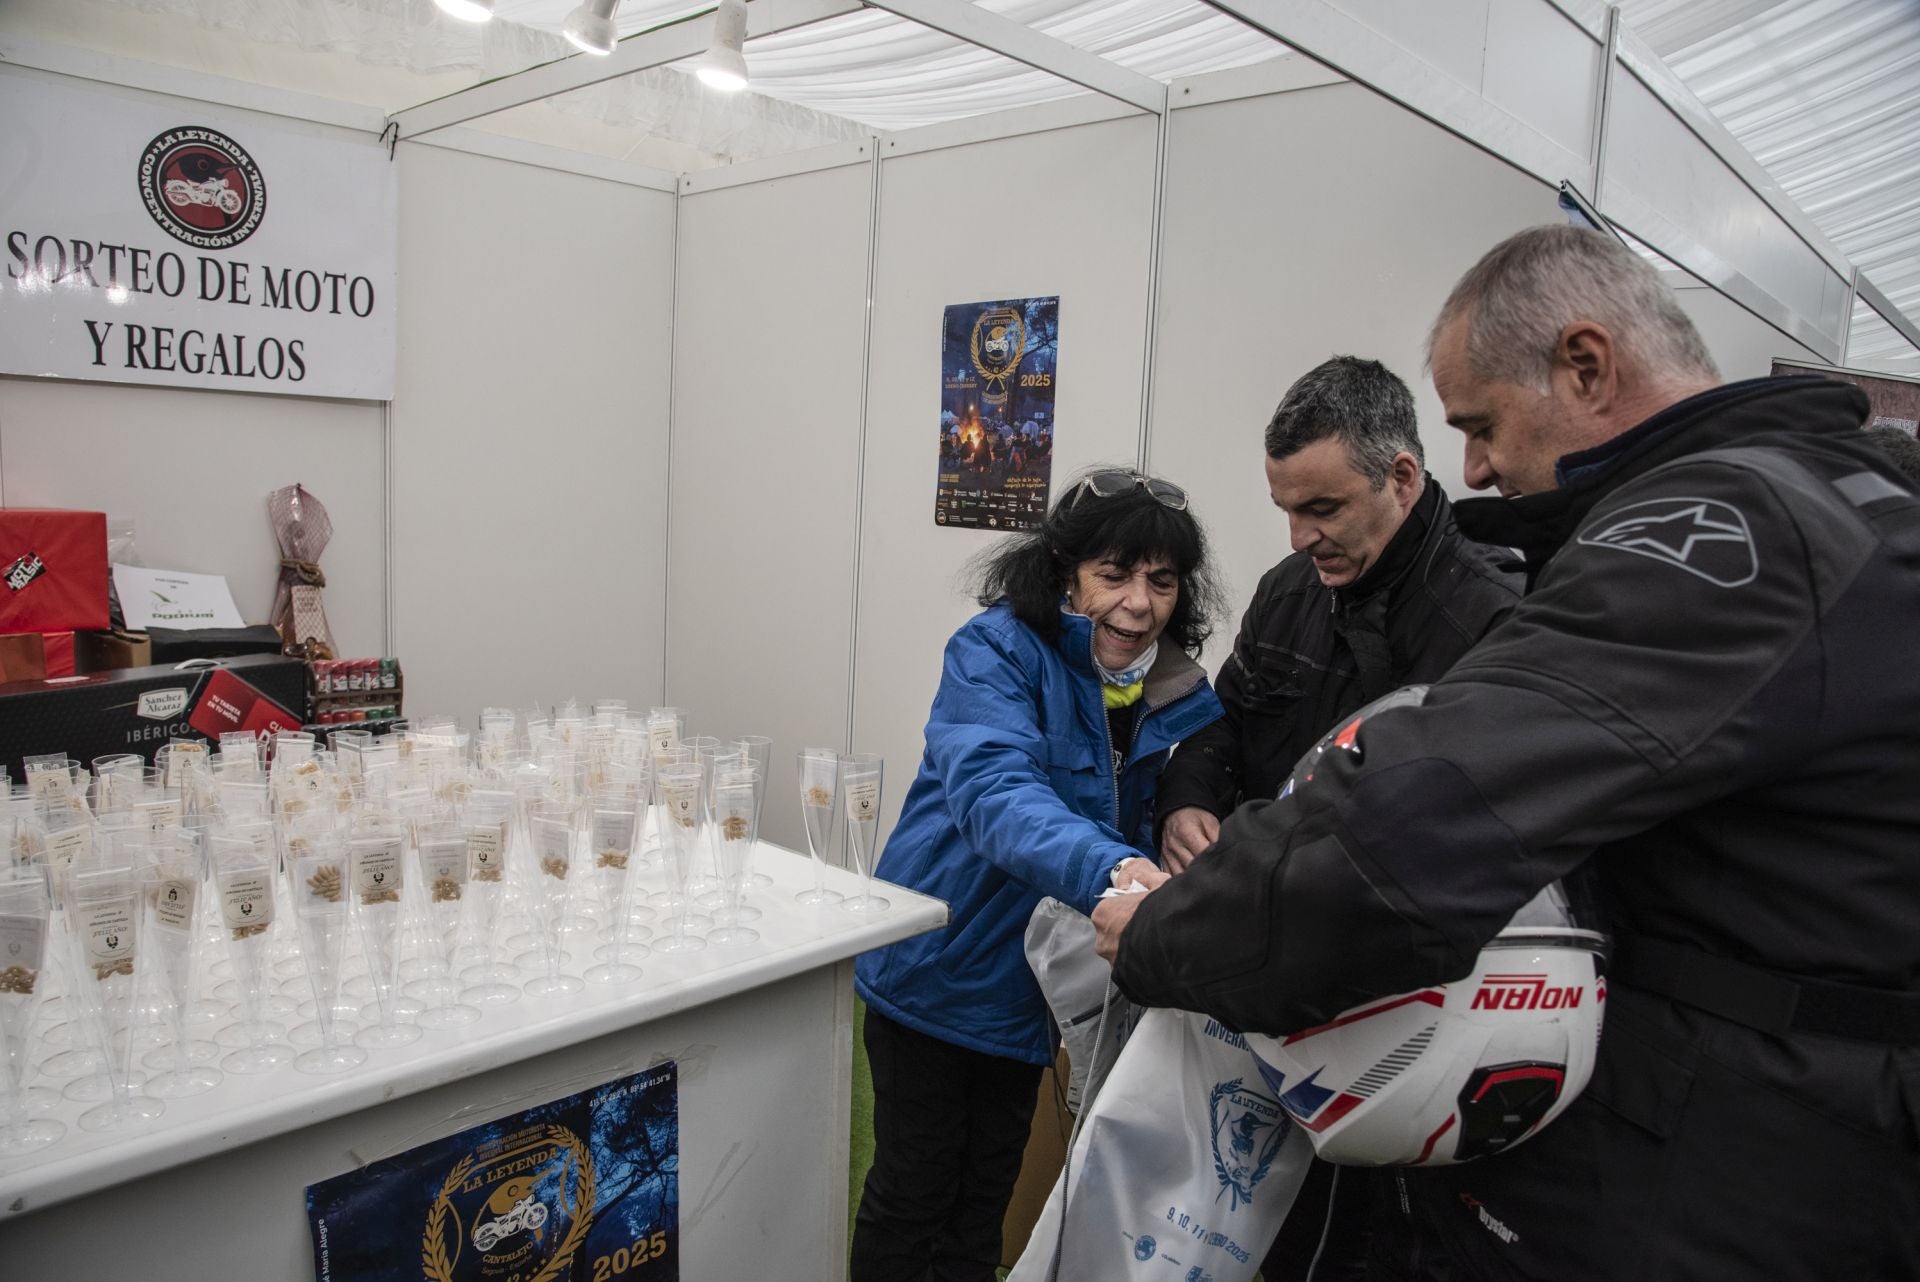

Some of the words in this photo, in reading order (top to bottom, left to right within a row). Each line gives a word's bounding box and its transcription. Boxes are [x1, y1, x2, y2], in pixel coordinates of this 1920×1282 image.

[156, 135, 177, 152] LA
[176, 130, 249, 166] LEYENDA
[142, 153, 233, 247] CONCENTRACIÓN
[233, 169, 265, 238] INVERNAL
[6, 230, 186, 298] SORTEO
[196, 256, 252, 305] DE
[261, 265, 375, 318] MOTO
[83, 319, 114, 366] Y
[123, 323, 306, 382] REGALOS
[1020, 374, 1051, 387] 2025
[147, 702, 181, 713] Alcaraz
[211, 694, 220, 703] TU
[126, 721, 197, 744] IBÉRICO
[1470, 980, 1584, 1010] NOLAN
[1204, 1019, 1249, 1052] INVERN
[463, 1176, 483, 1193] LA
[486, 1147, 558, 1184] LEYENDA
[319, 1219, 328, 1248] Alegre
[1167, 1206, 1176, 1223] 9,
[1178, 1213, 1190, 1231] 10,
[1225, 1241, 1251, 1264] 2025
[483, 1241, 534, 1264] CANTALEJO
[593, 1231, 667, 1282] 2025
